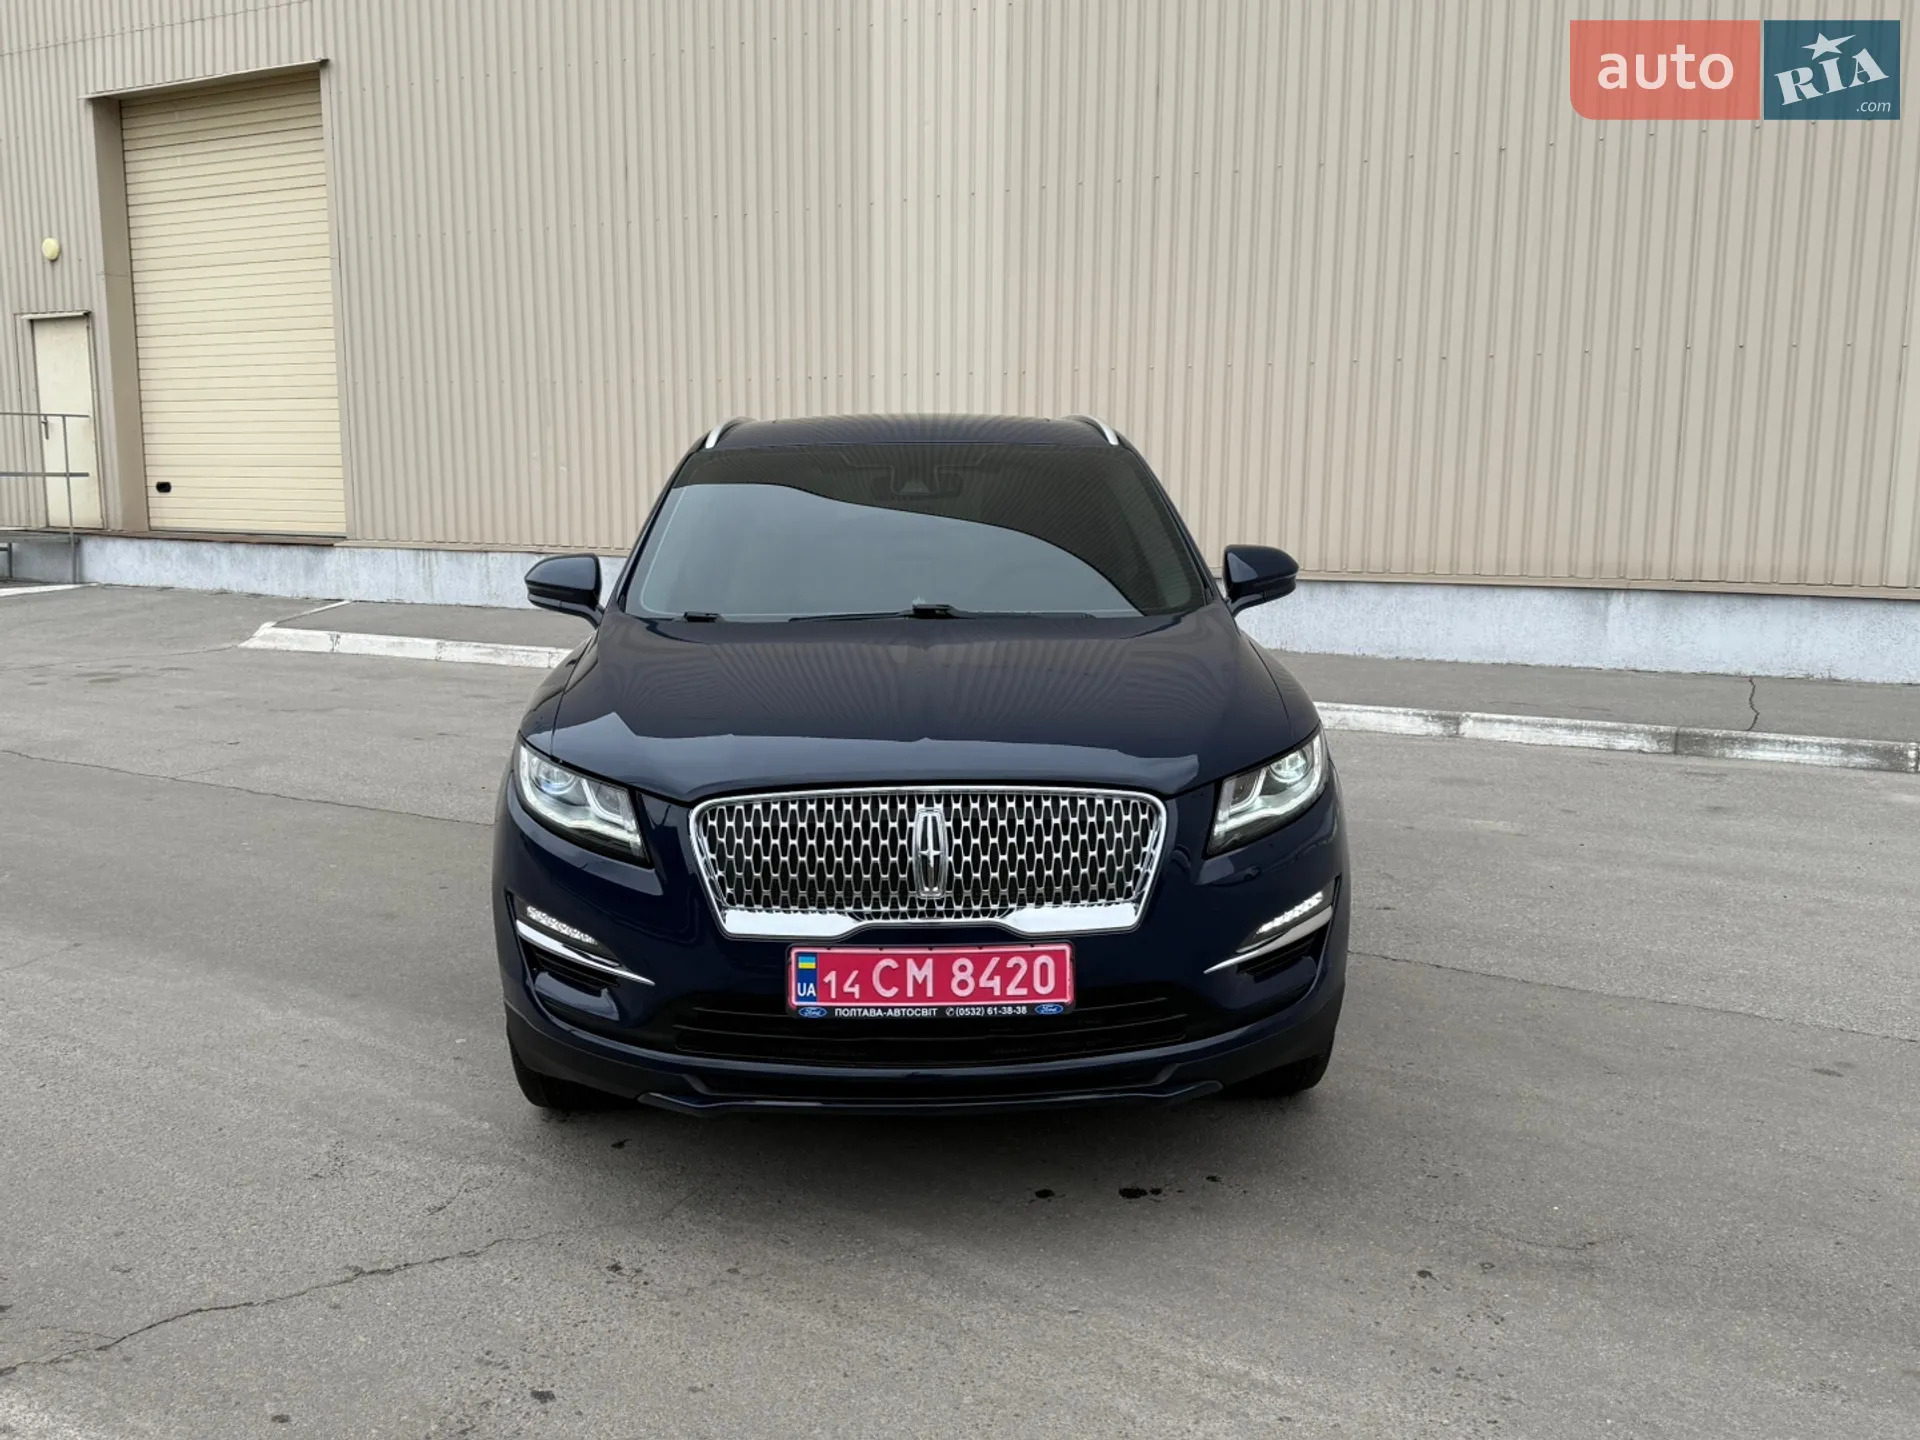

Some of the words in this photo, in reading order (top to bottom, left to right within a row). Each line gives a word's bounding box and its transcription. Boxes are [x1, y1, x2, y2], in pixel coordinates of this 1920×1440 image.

[823, 970, 860, 999] 14
[950, 954, 1056, 998] 8420
[797, 982, 817, 997] UA
[834, 1007, 938, 1018] ПОЛТАВА-АВТОСВІТ
[955, 1007, 985, 1016] (0532)
[987, 1006, 1028, 1015] 61-38-38
